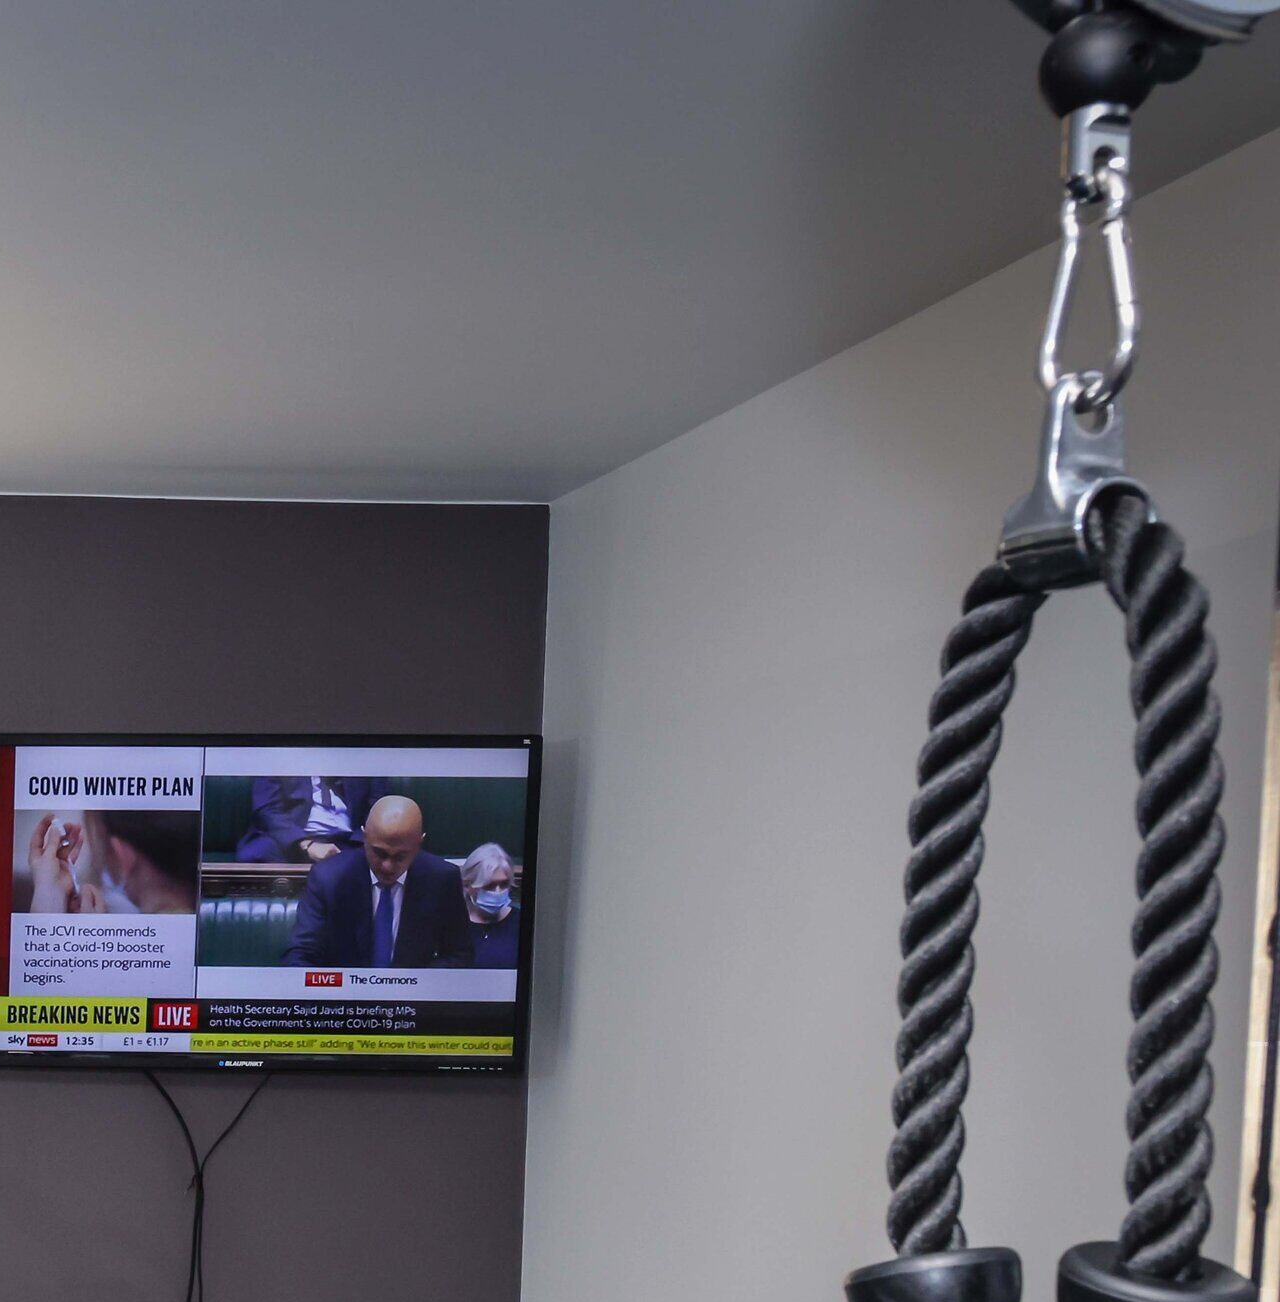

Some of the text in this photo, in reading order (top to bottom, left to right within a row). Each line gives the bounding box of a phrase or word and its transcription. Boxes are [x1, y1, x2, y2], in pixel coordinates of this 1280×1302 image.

[28, 776, 194, 797] COVID WINTER PLAN
[24, 924, 157, 938] The JCVI recommends
[24, 941, 166, 954] that a Covid-19 booster
[23, 956, 171, 971] vaccinations programme
[23, 972, 66, 985] begins.
[311, 974, 336, 984] LIVE
[349, 975, 418, 986] The Commons
[6, 1004, 141, 1026] BREAKING NEWS
[157, 1005, 192, 1027] LIVE
[209, 1004, 416, 1018] Health Secretary Sajid Javid is briefing MPs
[209, 1017, 416, 1030] on the Government's winter COVID-19 plan
[7, 1034, 57, 1047] sky news
[65, 1036, 95, 1046] 12:35
[123, 1037, 134, 1046] £1
[146, 1037, 169, 1047] €1.17
[217, 1039, 229, 1047] an
[231, 1037, 261, 1048] active
[263, 1038, 294, 1050] phase
[319, 1039, 354, 1051] adding
[378, 1039, 404, 1049] know
[407, 1040, 426, 1050] this
[428, 1041, 460, 1050] winter
[462, 1041, 490, 1051] could
[225, 1060, 264, 1068] BLAUPUNKT
